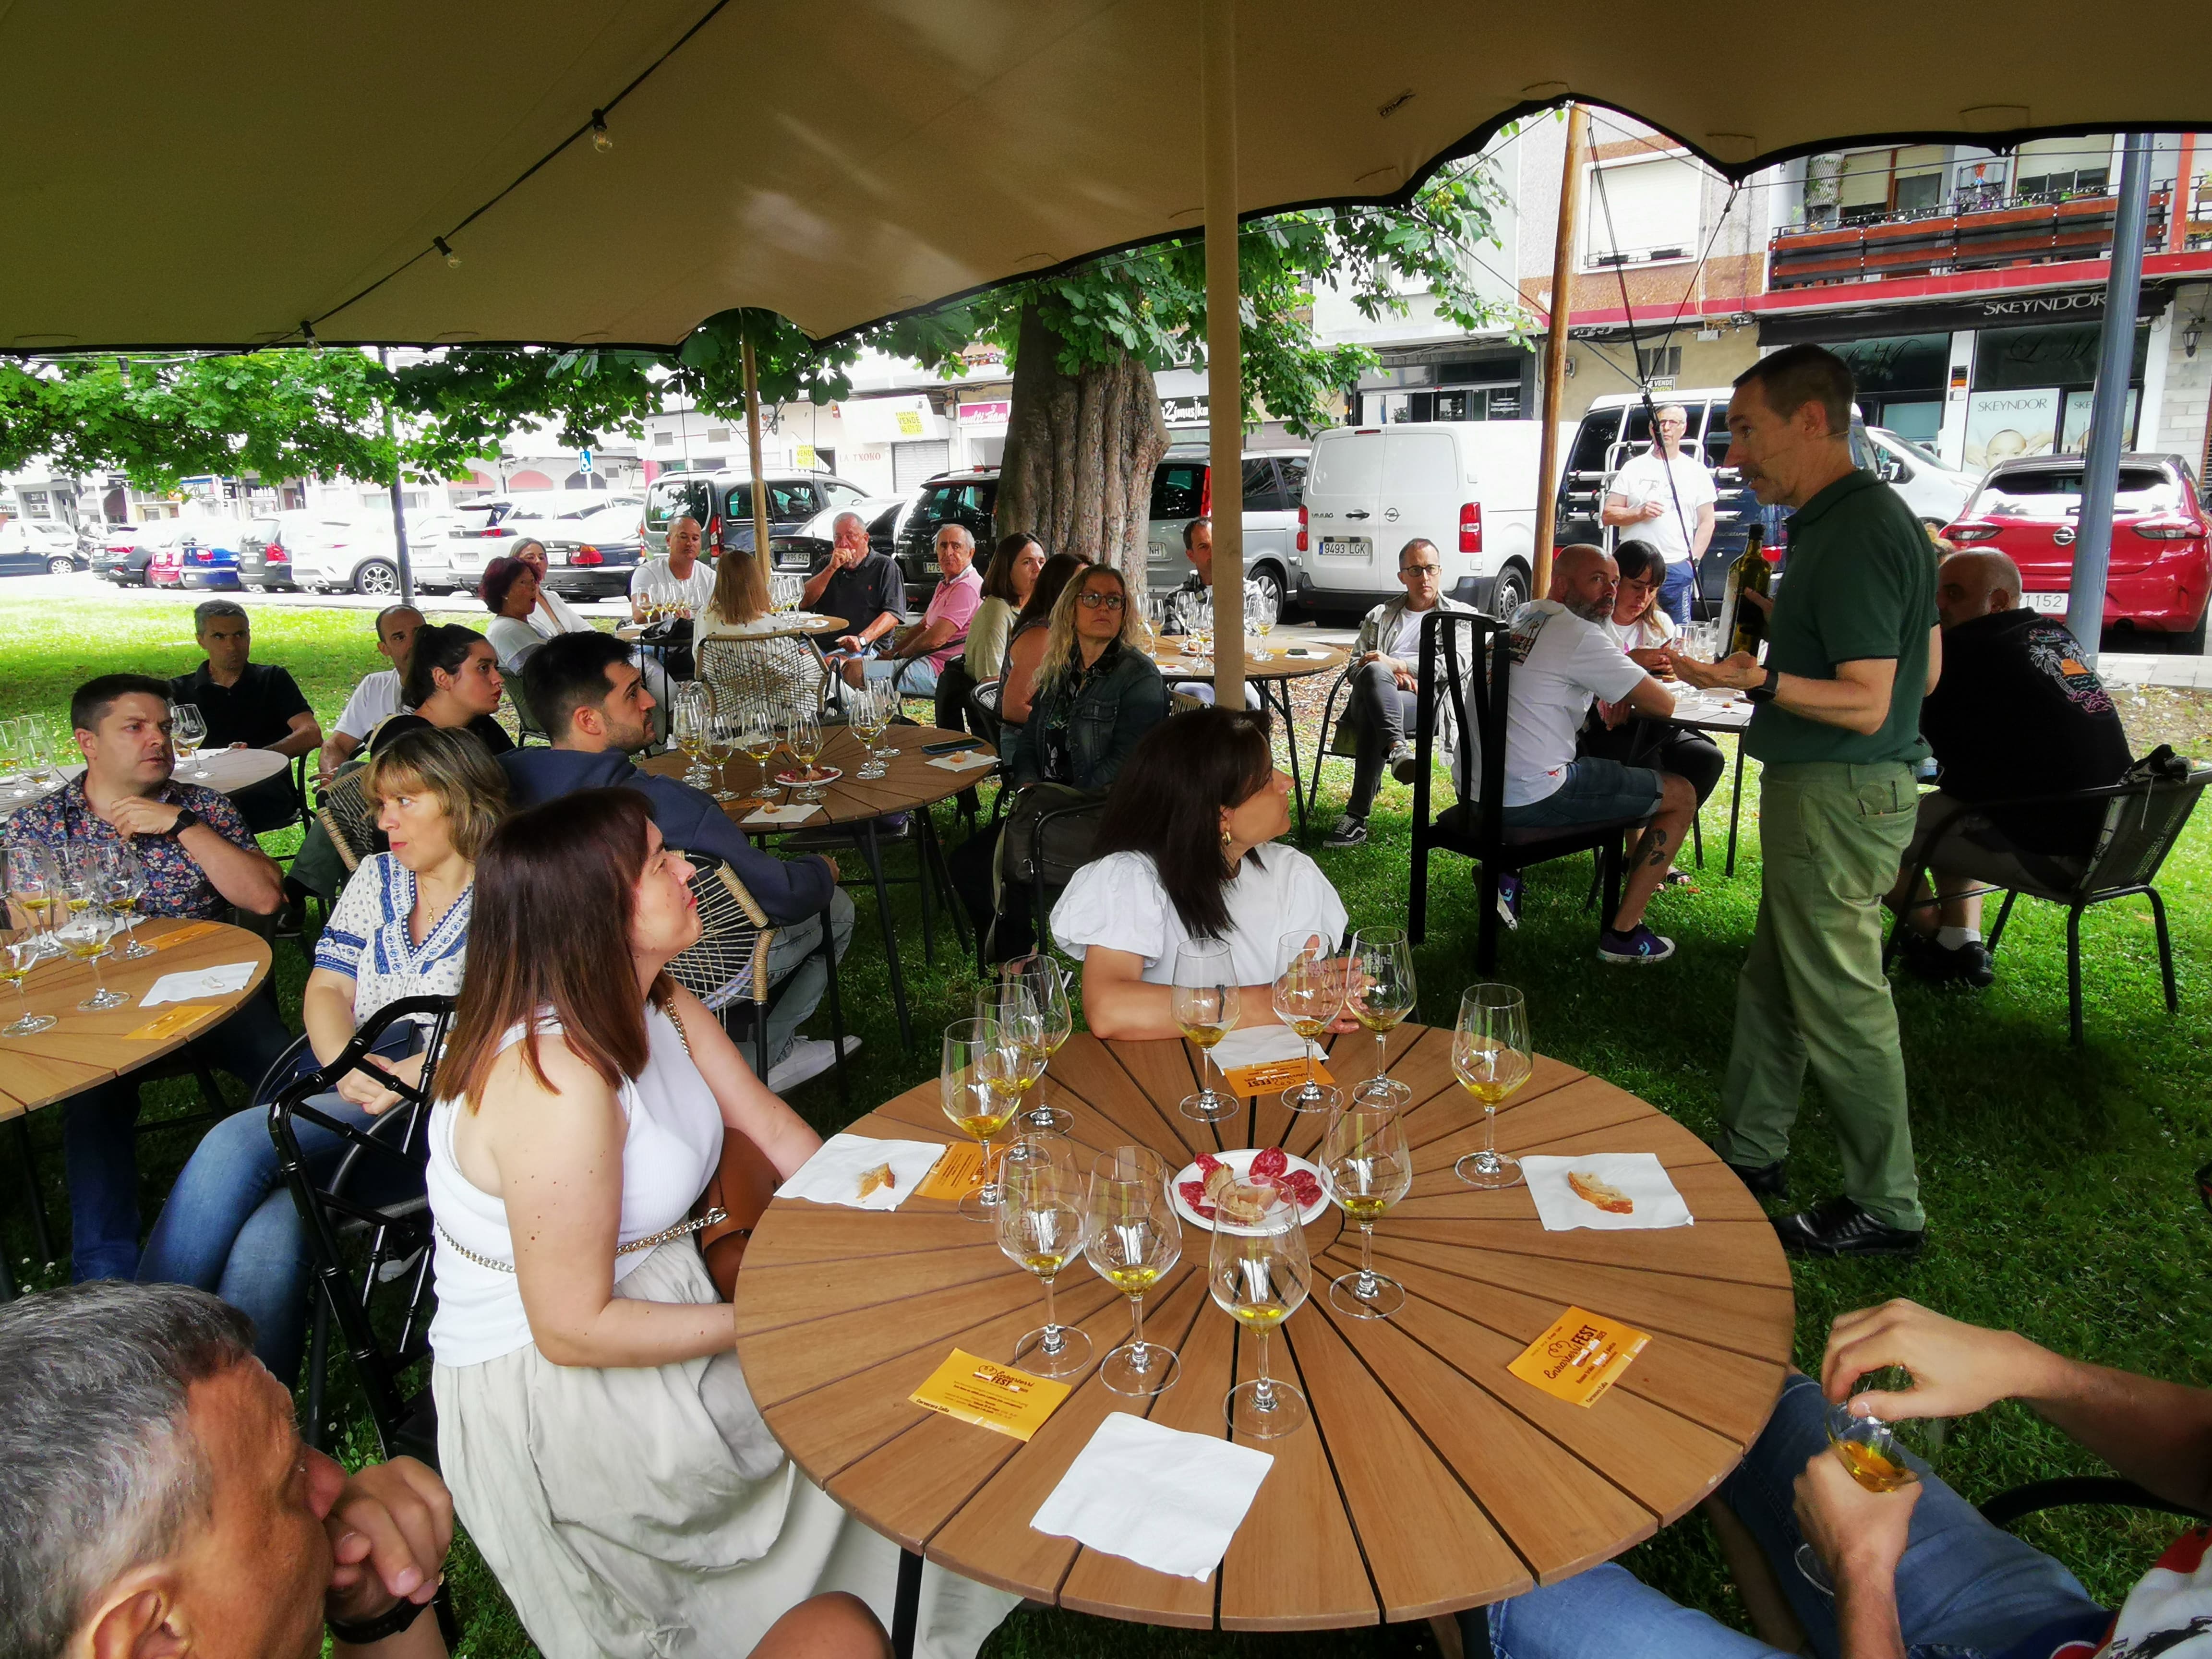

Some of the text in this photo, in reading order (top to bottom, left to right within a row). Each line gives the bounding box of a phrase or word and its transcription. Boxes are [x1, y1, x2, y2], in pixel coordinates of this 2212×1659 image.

[1983, 292, 2107, 316] SKEYNDOR
[1978, 398, 2047, 412] SKEYNDOR
[897, 416, 921, 424] VENDE
[853, 453, 881, 461] TXOKO
[1149, 545, 1159, 554] NH
[1325, 543, 1365, 554] 9493 LGK
[928, 563, 941, 572] 276
[2026, 595, 2062, 607] 1152
[1248, 1080, 1272, 1088] FEST
[1571, 1324, 1598, 1346] FEST
[991, 1376, 1010, 1387] FEST
